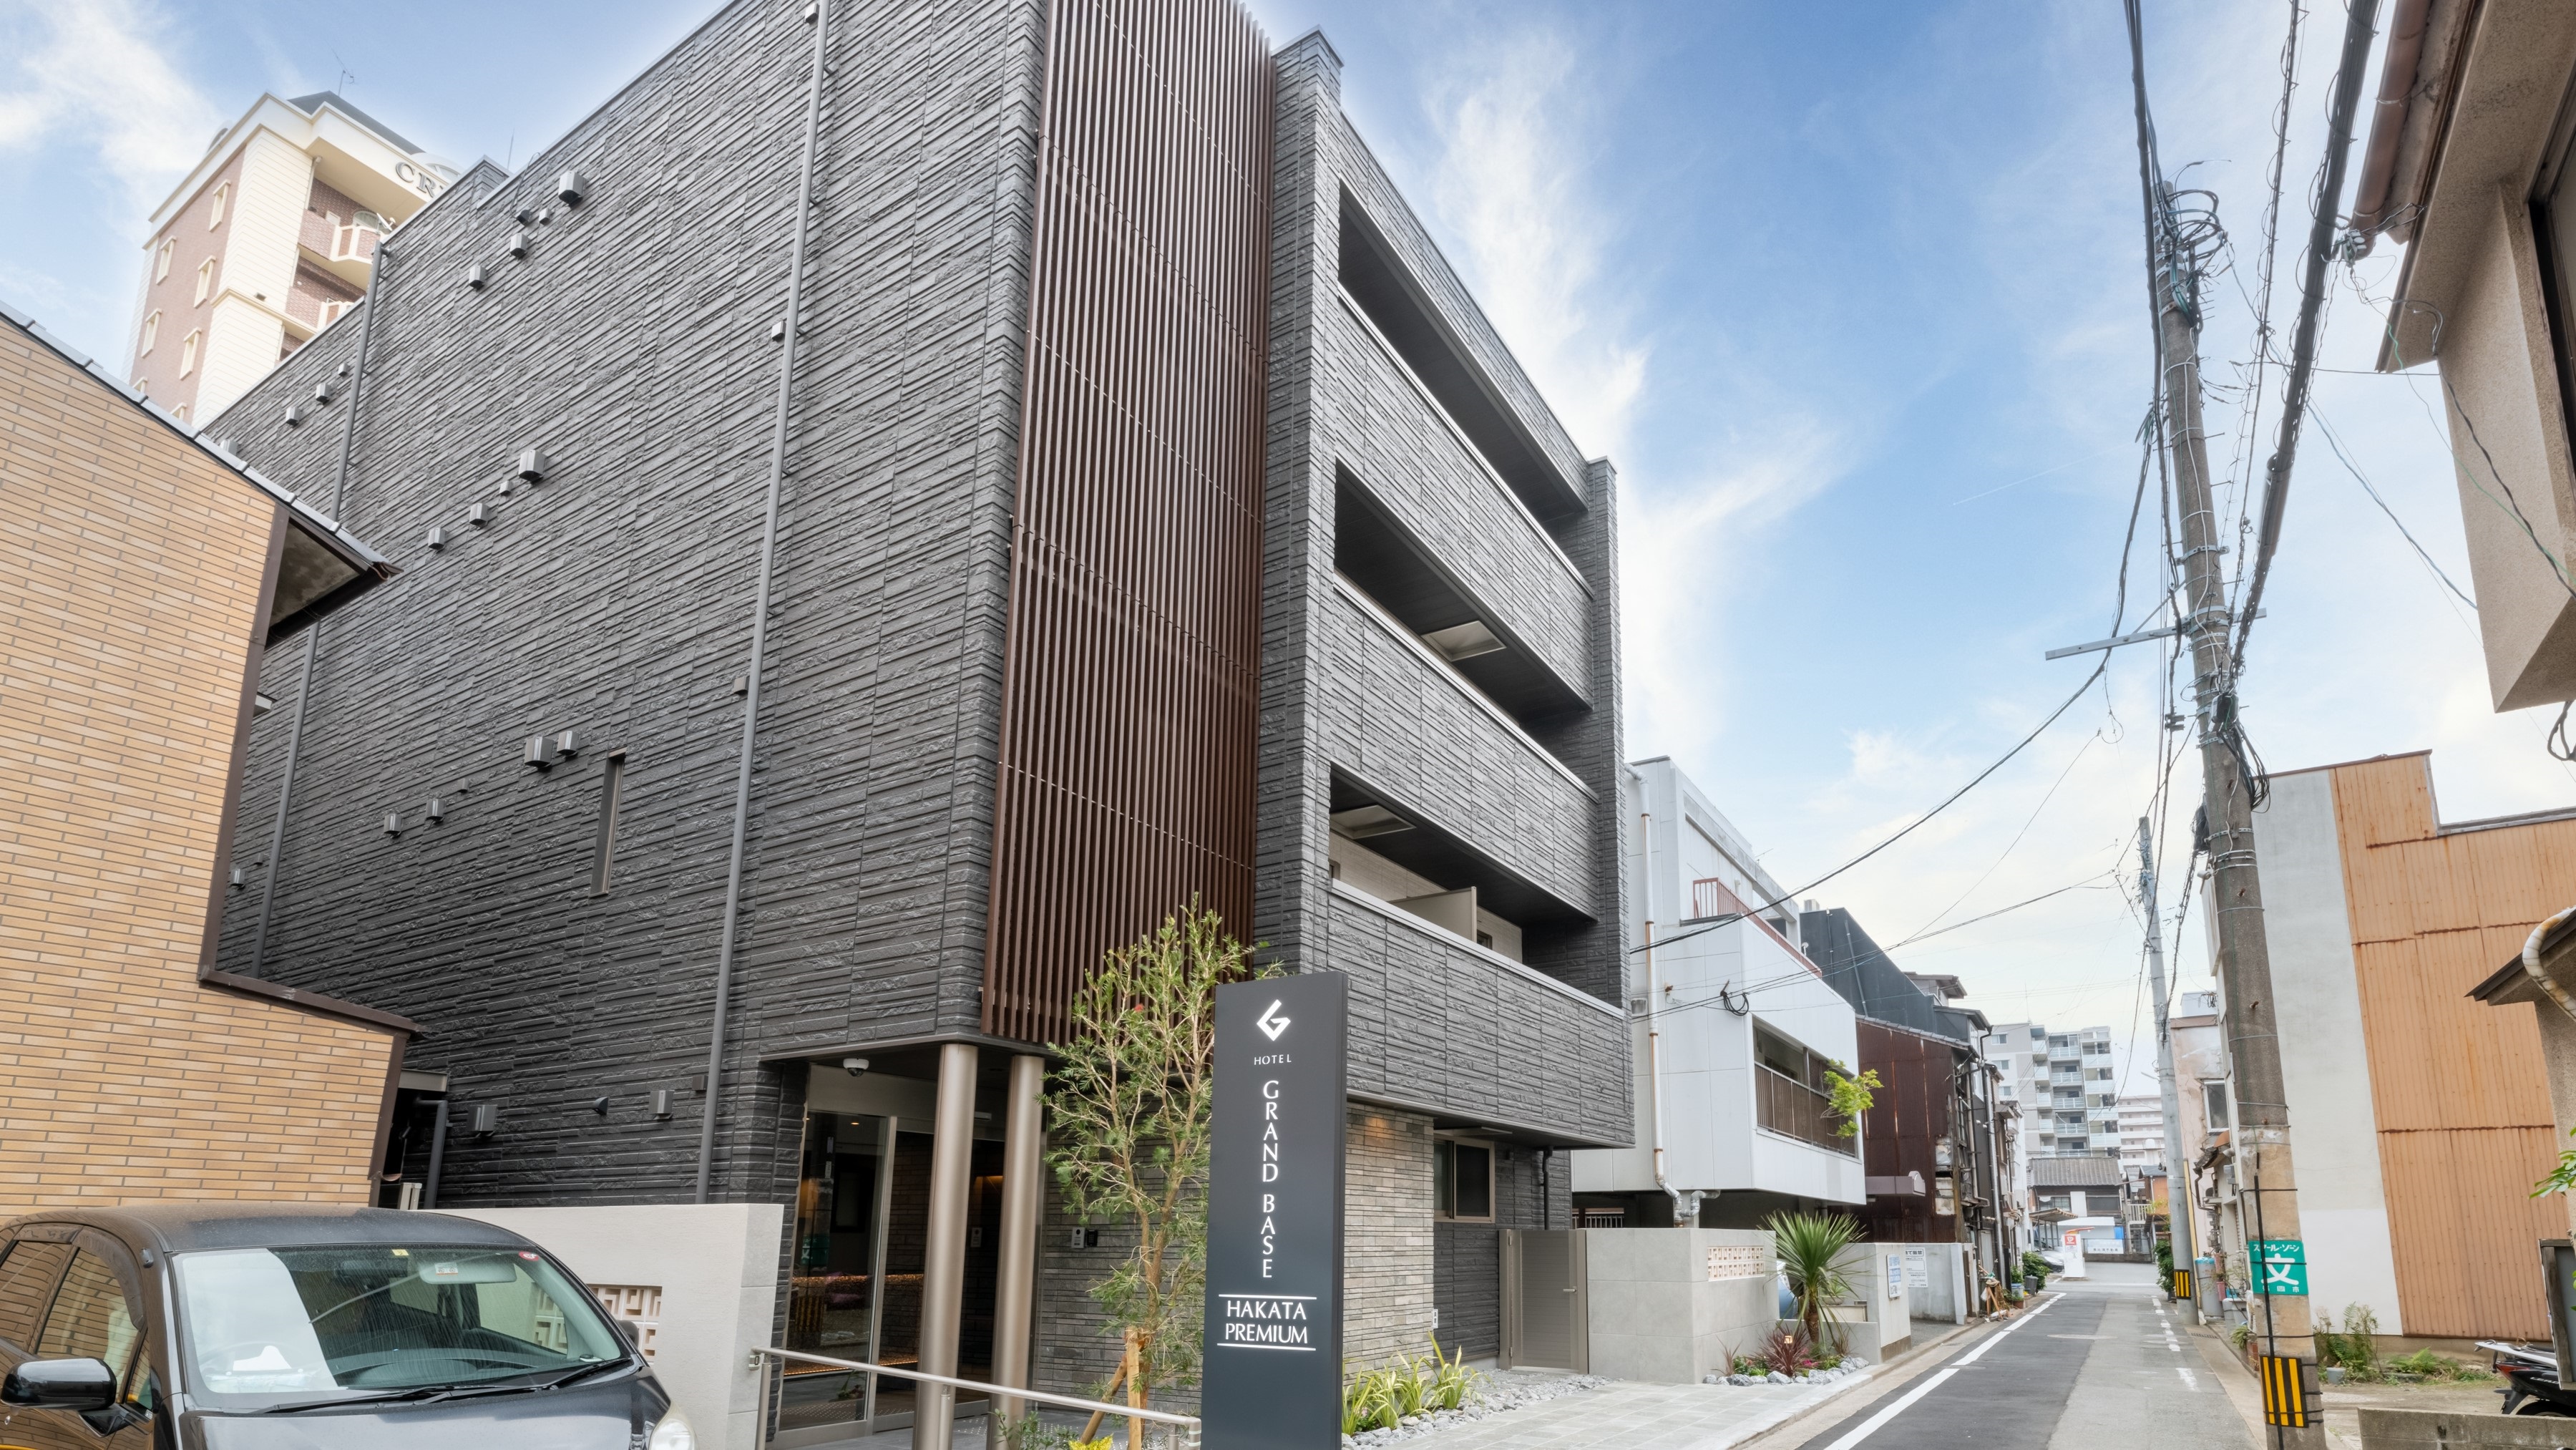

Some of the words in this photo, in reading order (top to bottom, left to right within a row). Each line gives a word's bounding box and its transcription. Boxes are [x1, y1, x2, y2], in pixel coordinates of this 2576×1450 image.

[396, 162, 443, 198] CR
[1254, 1054, 1292, 1065] HOTEL
[1262, 1080, 1279, 1182] GRAND
[1260, 1194, 1276, 1278] BASE
[2260, 1253, 2299, 1285] 文
[1227, 1300, 1307, 1320] HAKATA
[1225, 1323, 1308, 1344] PREMIUM
